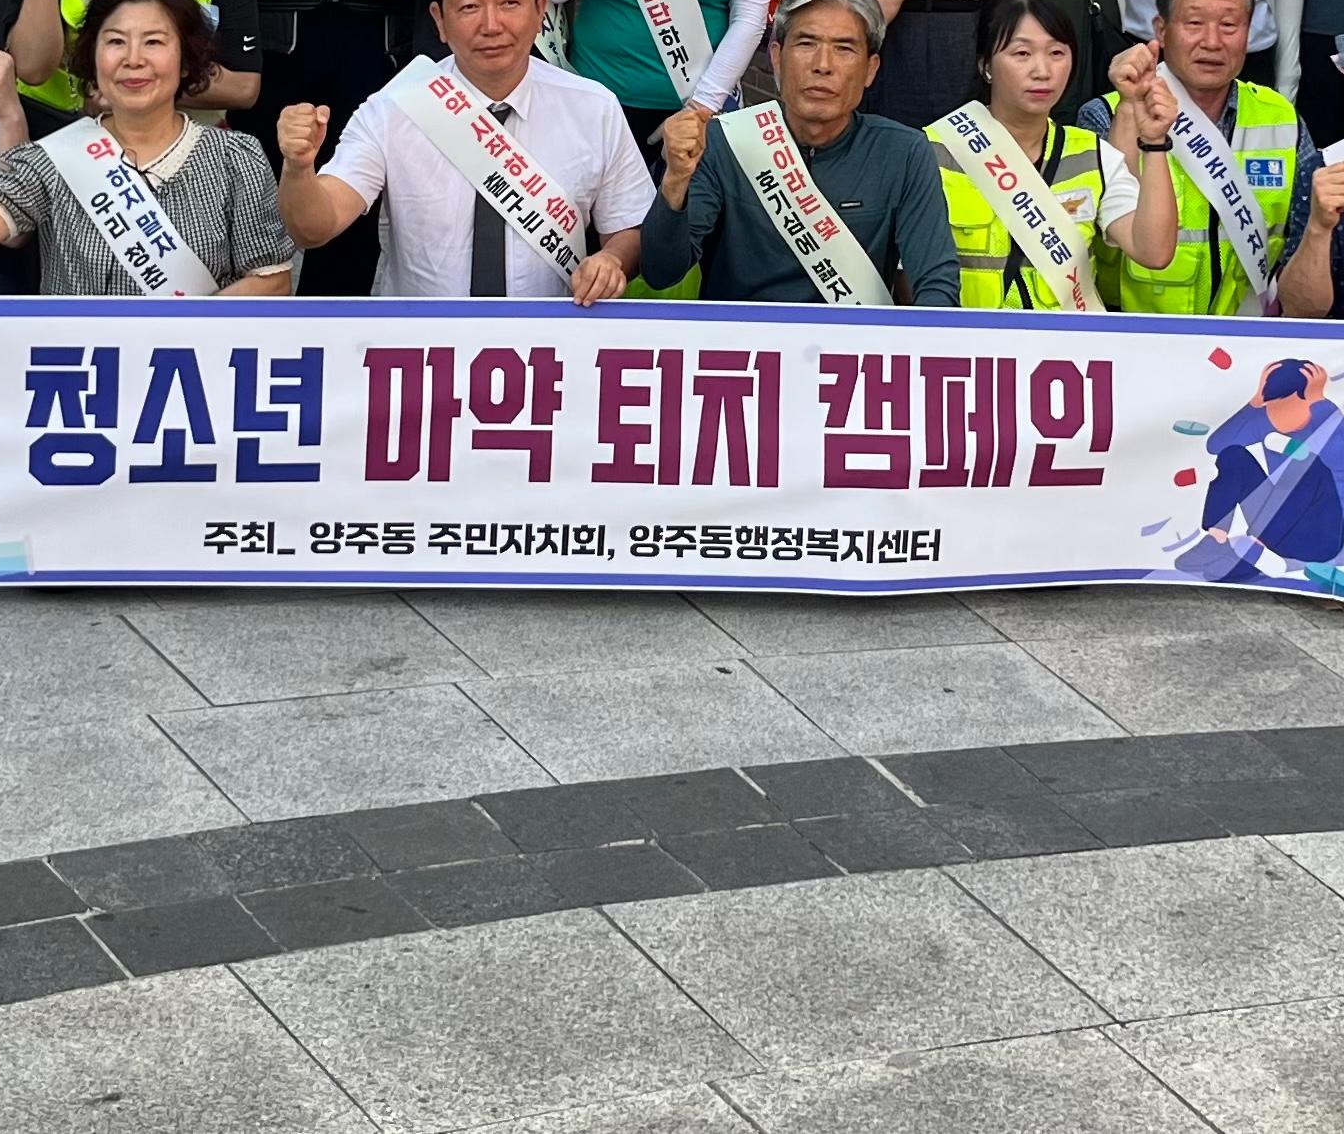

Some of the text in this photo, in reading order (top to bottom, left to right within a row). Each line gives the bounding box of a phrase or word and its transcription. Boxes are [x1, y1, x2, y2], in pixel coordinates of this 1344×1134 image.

[86, 137, 178, 258] 약 하지 말자
[428, 75, 578, 235] 마약 시작하는 순간
[482, 171, 545, 233] 출구는
[755, 109, 841, 242] 마약이라는 덫
[755, 169, 821, 257] 호기심에
[946, 111, 1087, 312] 마약에 NO 우리 삶에 YES
[91, 192, 168, 291] 우리 청춘
[25, 346, 1114, 490] 청소년 마약 퇴치 캠페인
[309, 521, 416, 556] 양주동
[427, 521, 615, 560] 주민자치회,
[628, 523, 942, 564] 양주동행정복지센터
